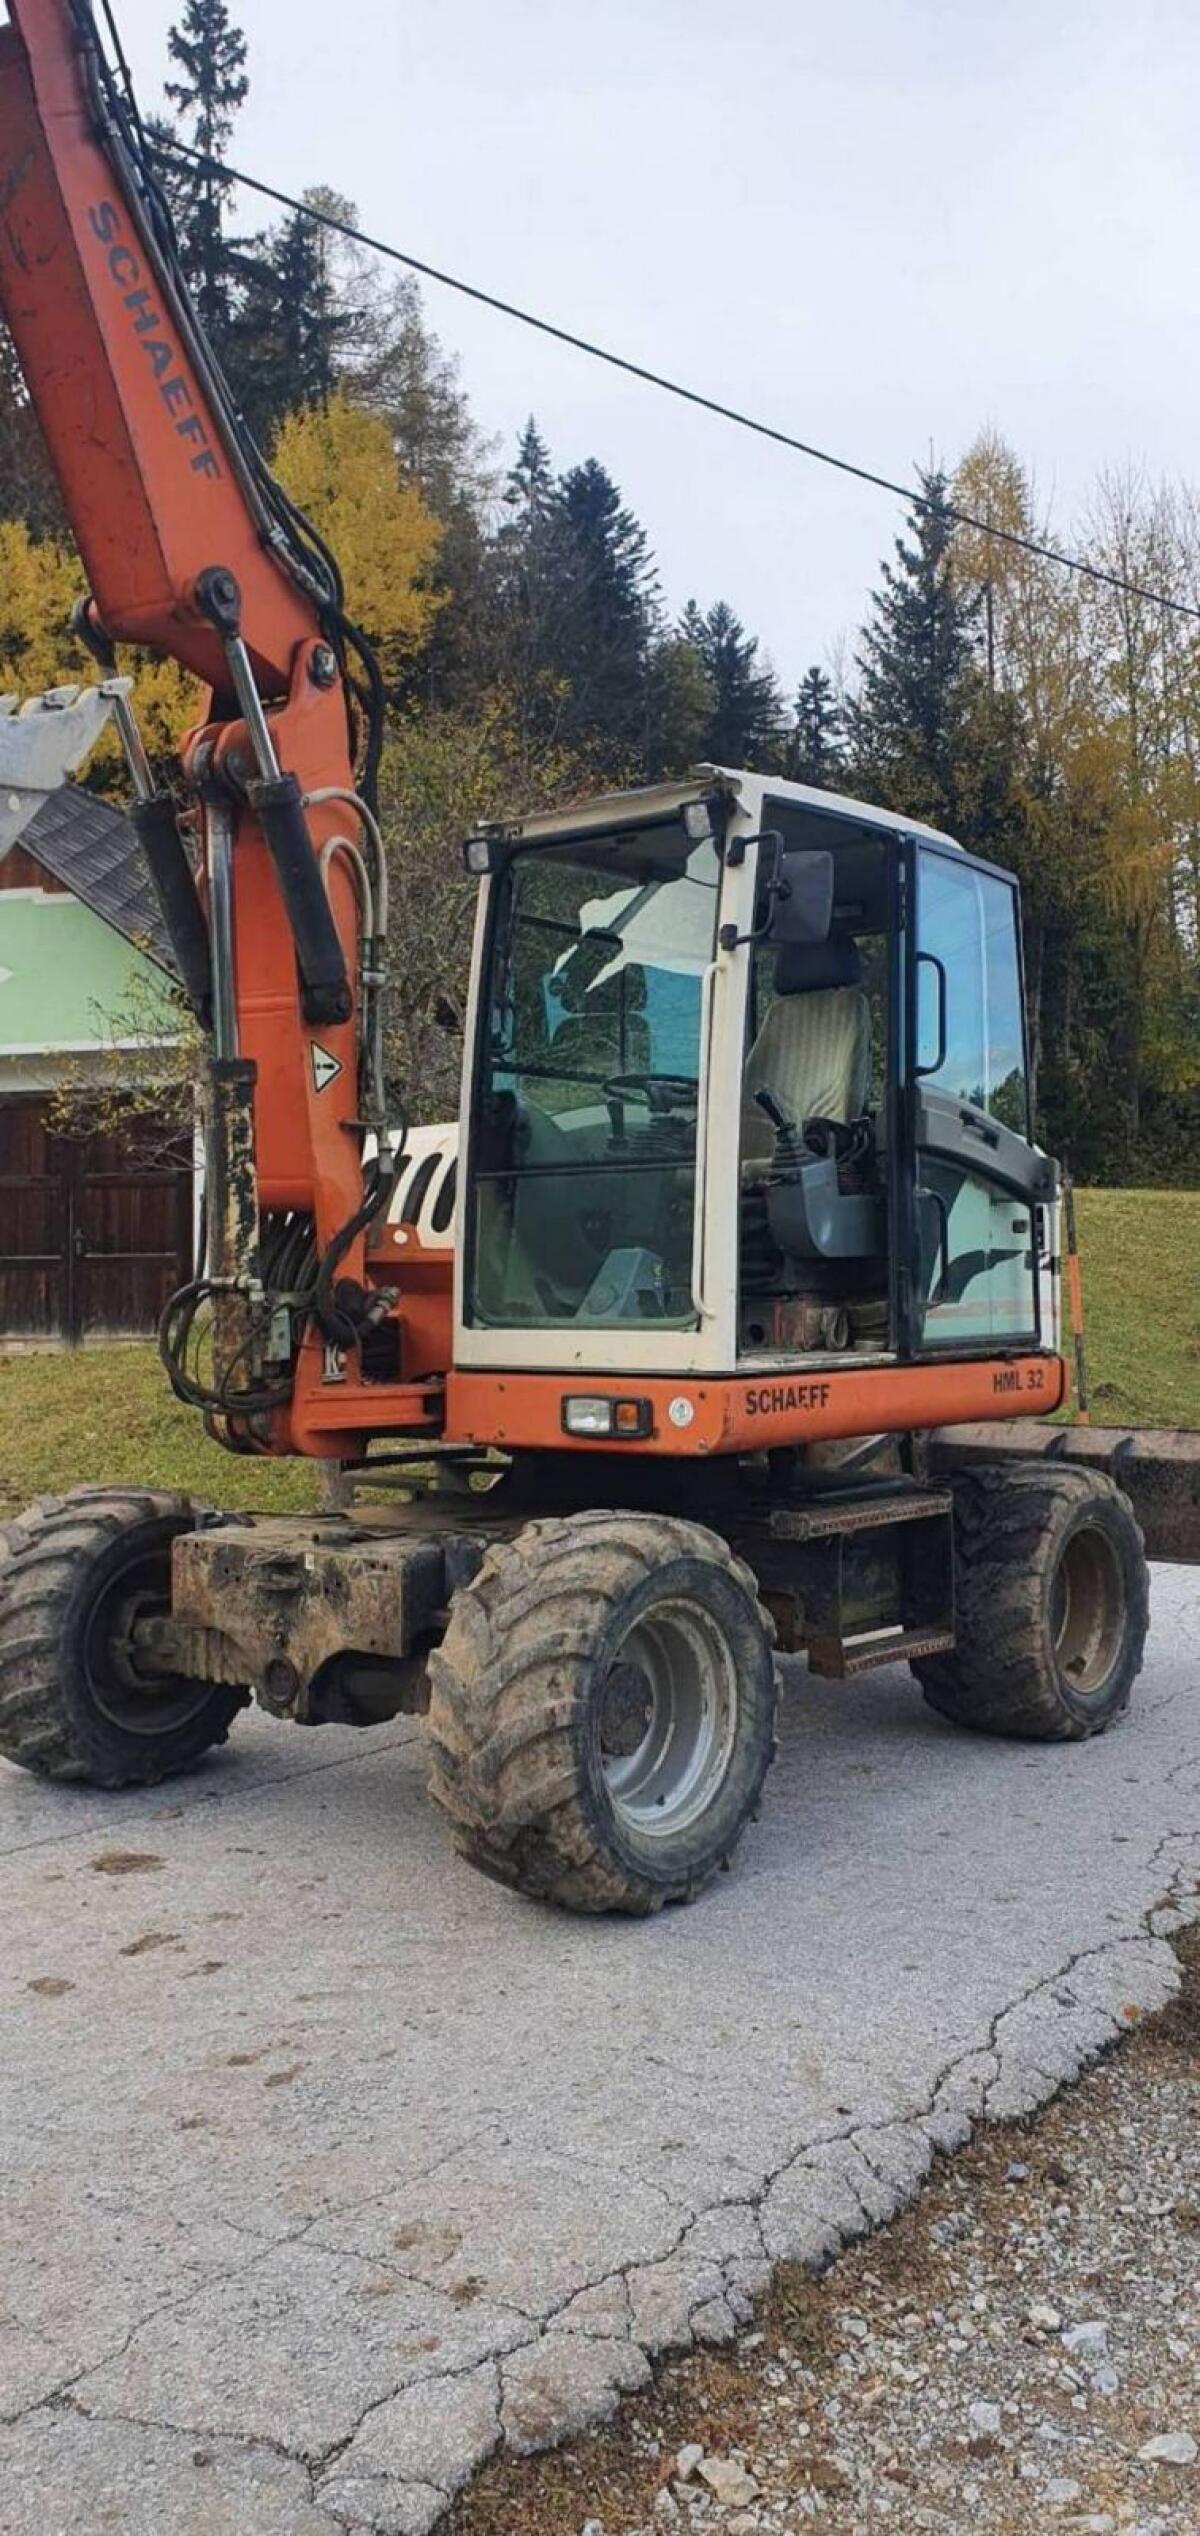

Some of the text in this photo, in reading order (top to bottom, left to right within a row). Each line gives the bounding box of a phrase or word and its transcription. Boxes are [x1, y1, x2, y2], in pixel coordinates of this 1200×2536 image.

[90, 201, 221, 479] SCHAEFF
[993, 1368, 1044, 1394] HML 32
[745, 1384, 830, 1414] SCHAEFF
